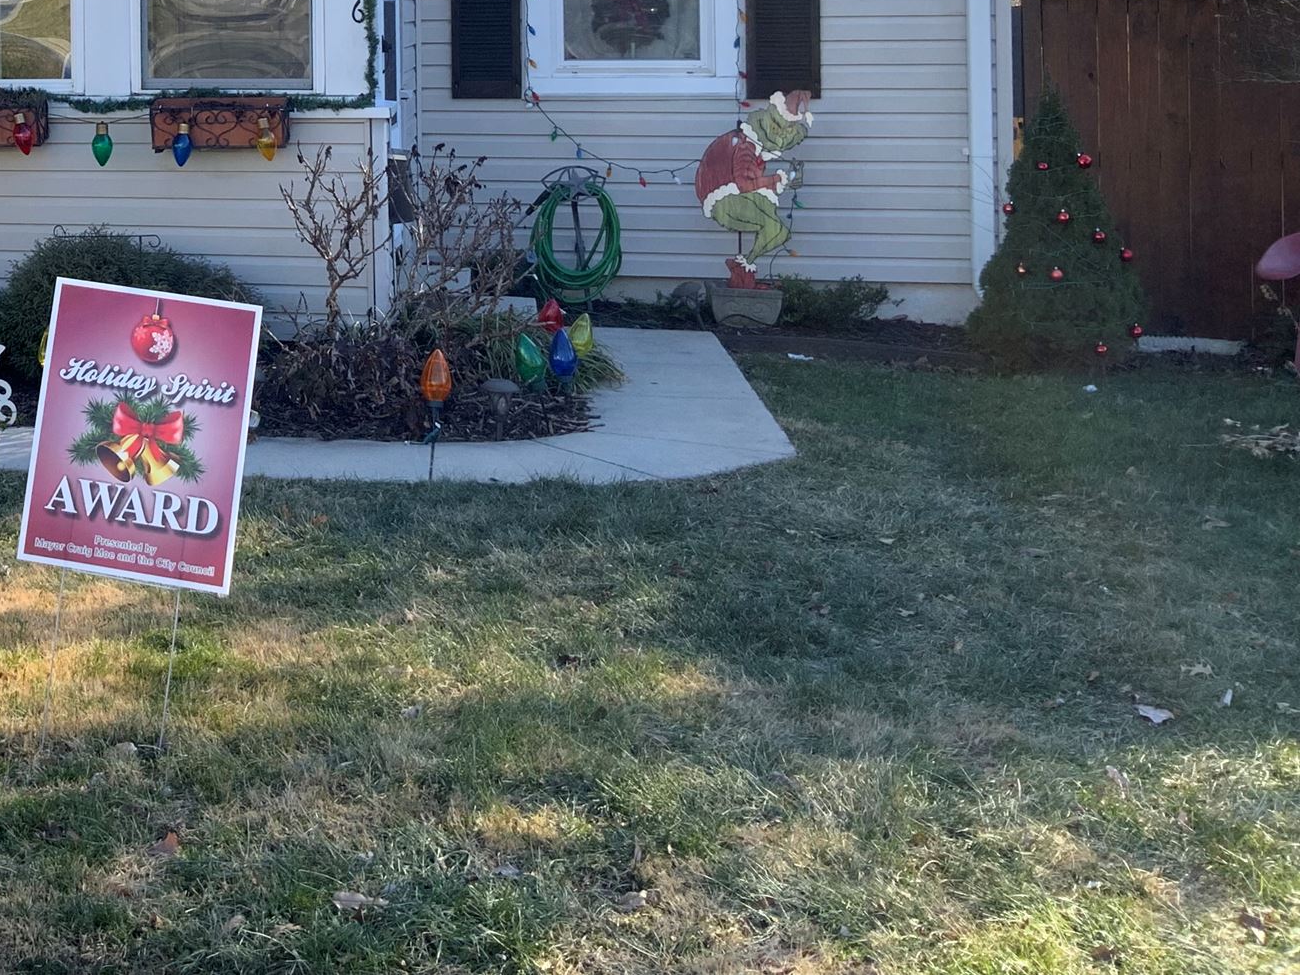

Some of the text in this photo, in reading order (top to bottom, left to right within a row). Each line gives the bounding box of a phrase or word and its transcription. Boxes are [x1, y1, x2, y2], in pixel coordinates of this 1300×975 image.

[59, 358, 236, 403] Holiday Spirit
[44, 475, 219, 534] AWARD
[34, 537, 215, 577] Mayor Craig Moe and the City Council
[93, 535, 157, 556] Presented by
